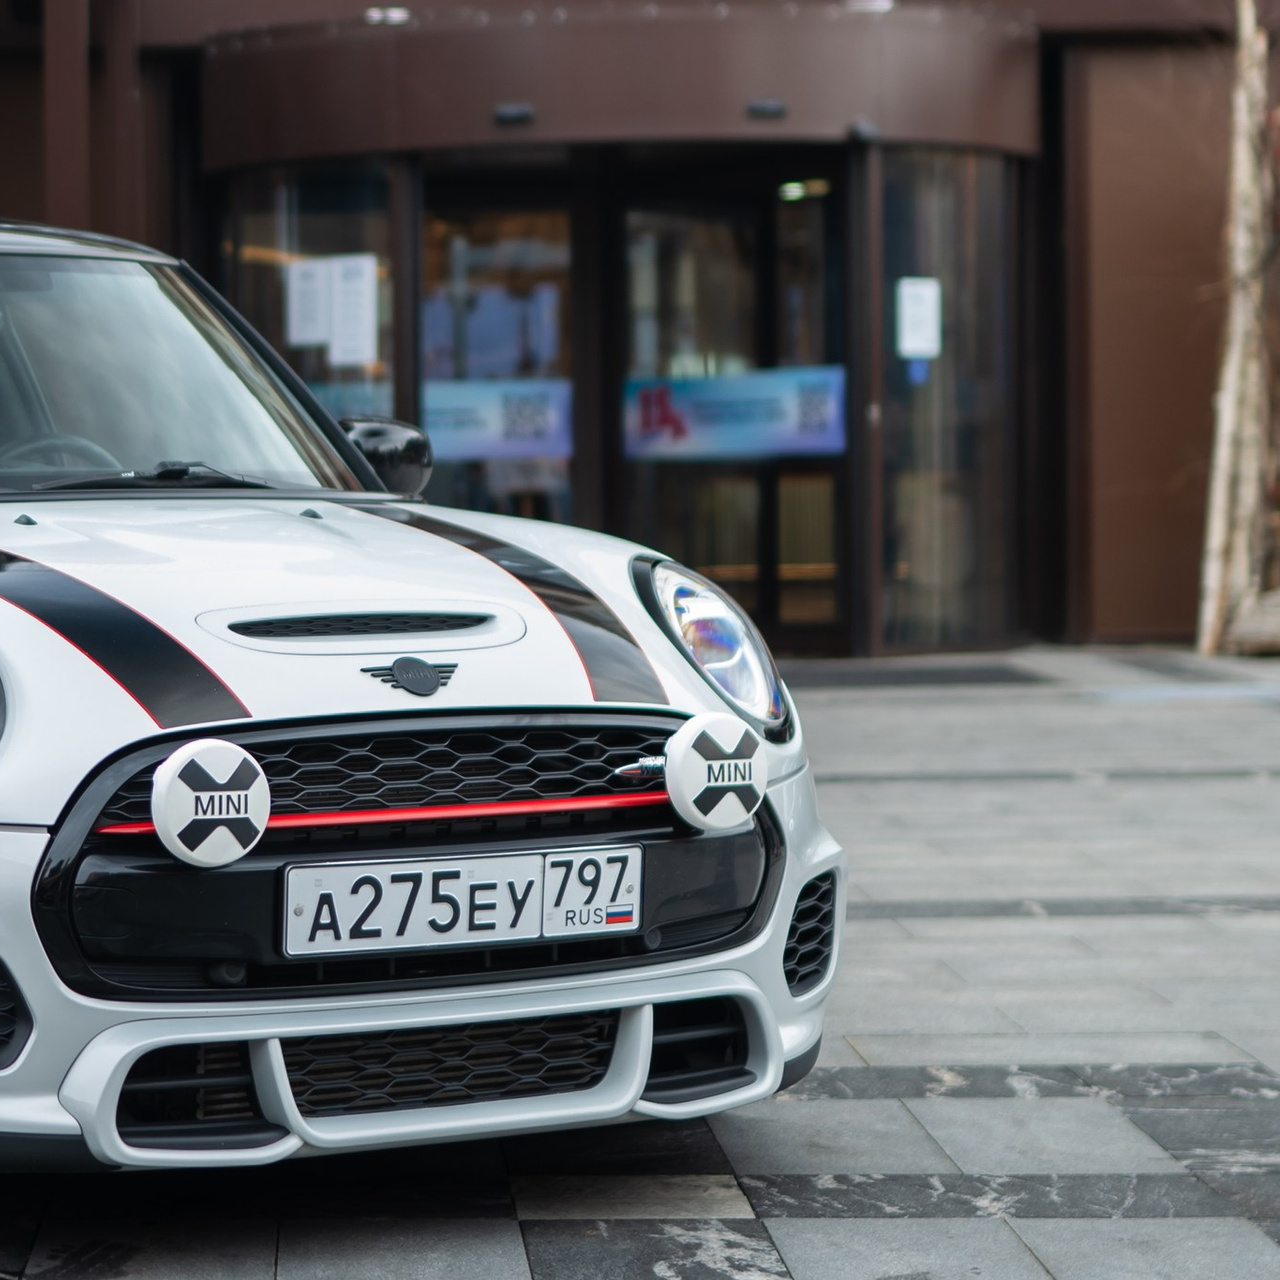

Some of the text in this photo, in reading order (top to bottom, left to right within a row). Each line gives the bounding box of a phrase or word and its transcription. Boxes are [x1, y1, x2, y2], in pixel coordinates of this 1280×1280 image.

[707, 761, 752, 783] MINI
[194, 794, 249, 816] MINI
[550, 854, 629, 908] 797
[564, 907, 604, 927] RUS
